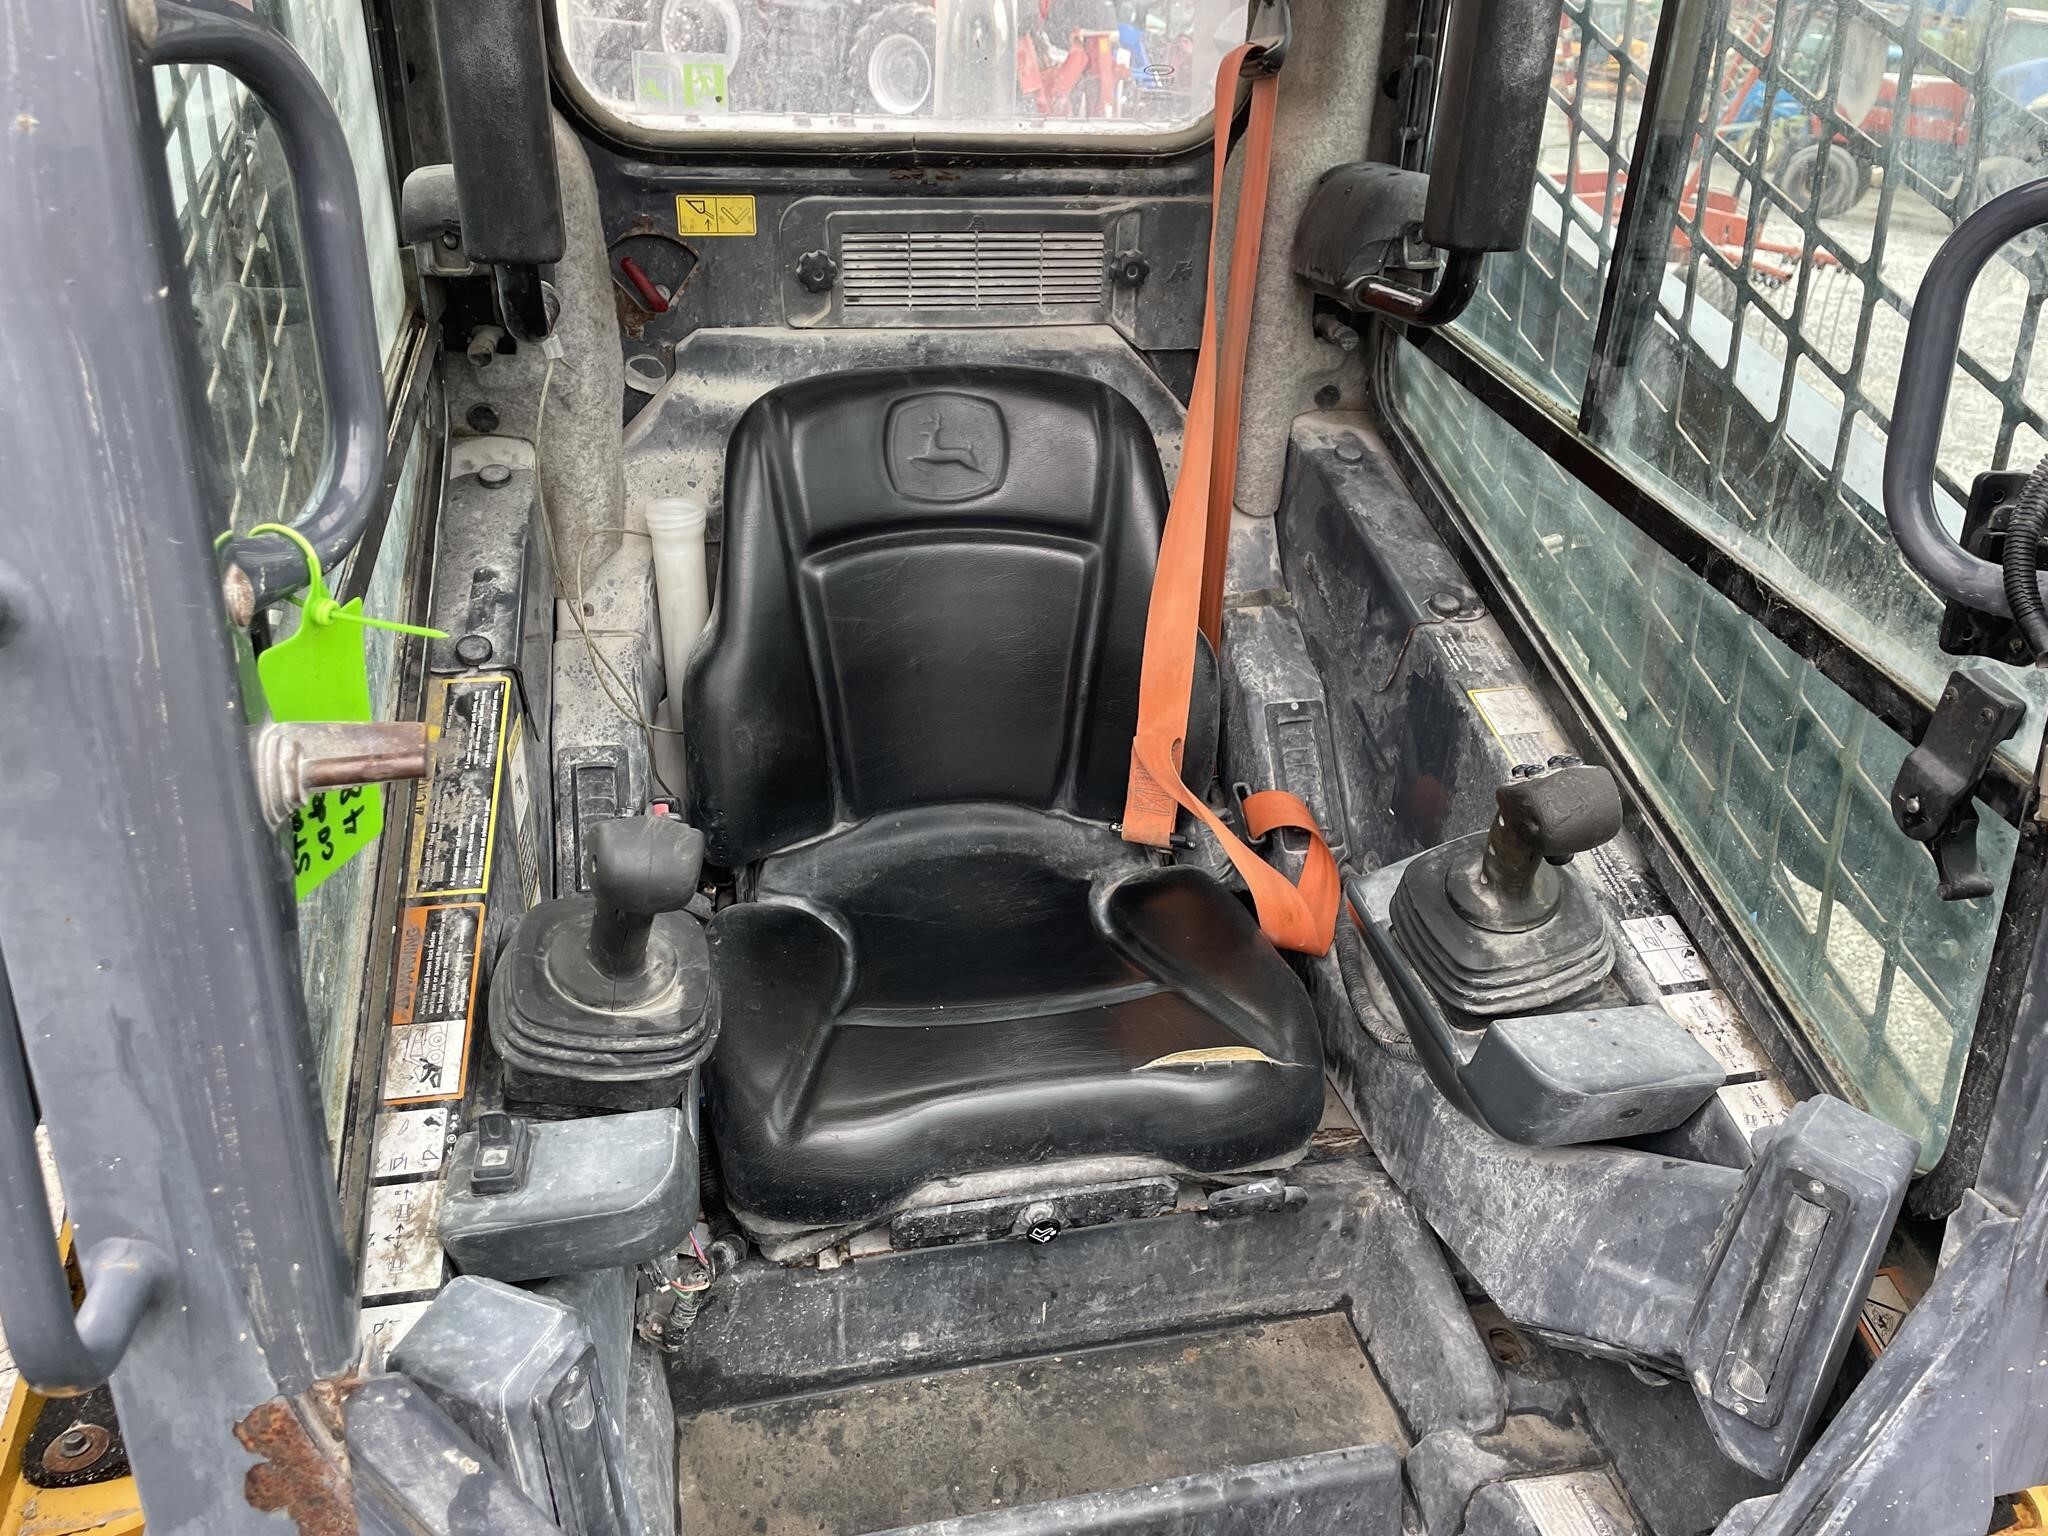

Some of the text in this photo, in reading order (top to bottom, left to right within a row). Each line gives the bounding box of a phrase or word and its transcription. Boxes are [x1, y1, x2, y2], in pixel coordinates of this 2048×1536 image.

[399, 926, 419, 993] WARNING
[424, 960, 432, 976] boom
[433, 956, 441, 975] around
[437, 985, 445, 1003] loader
